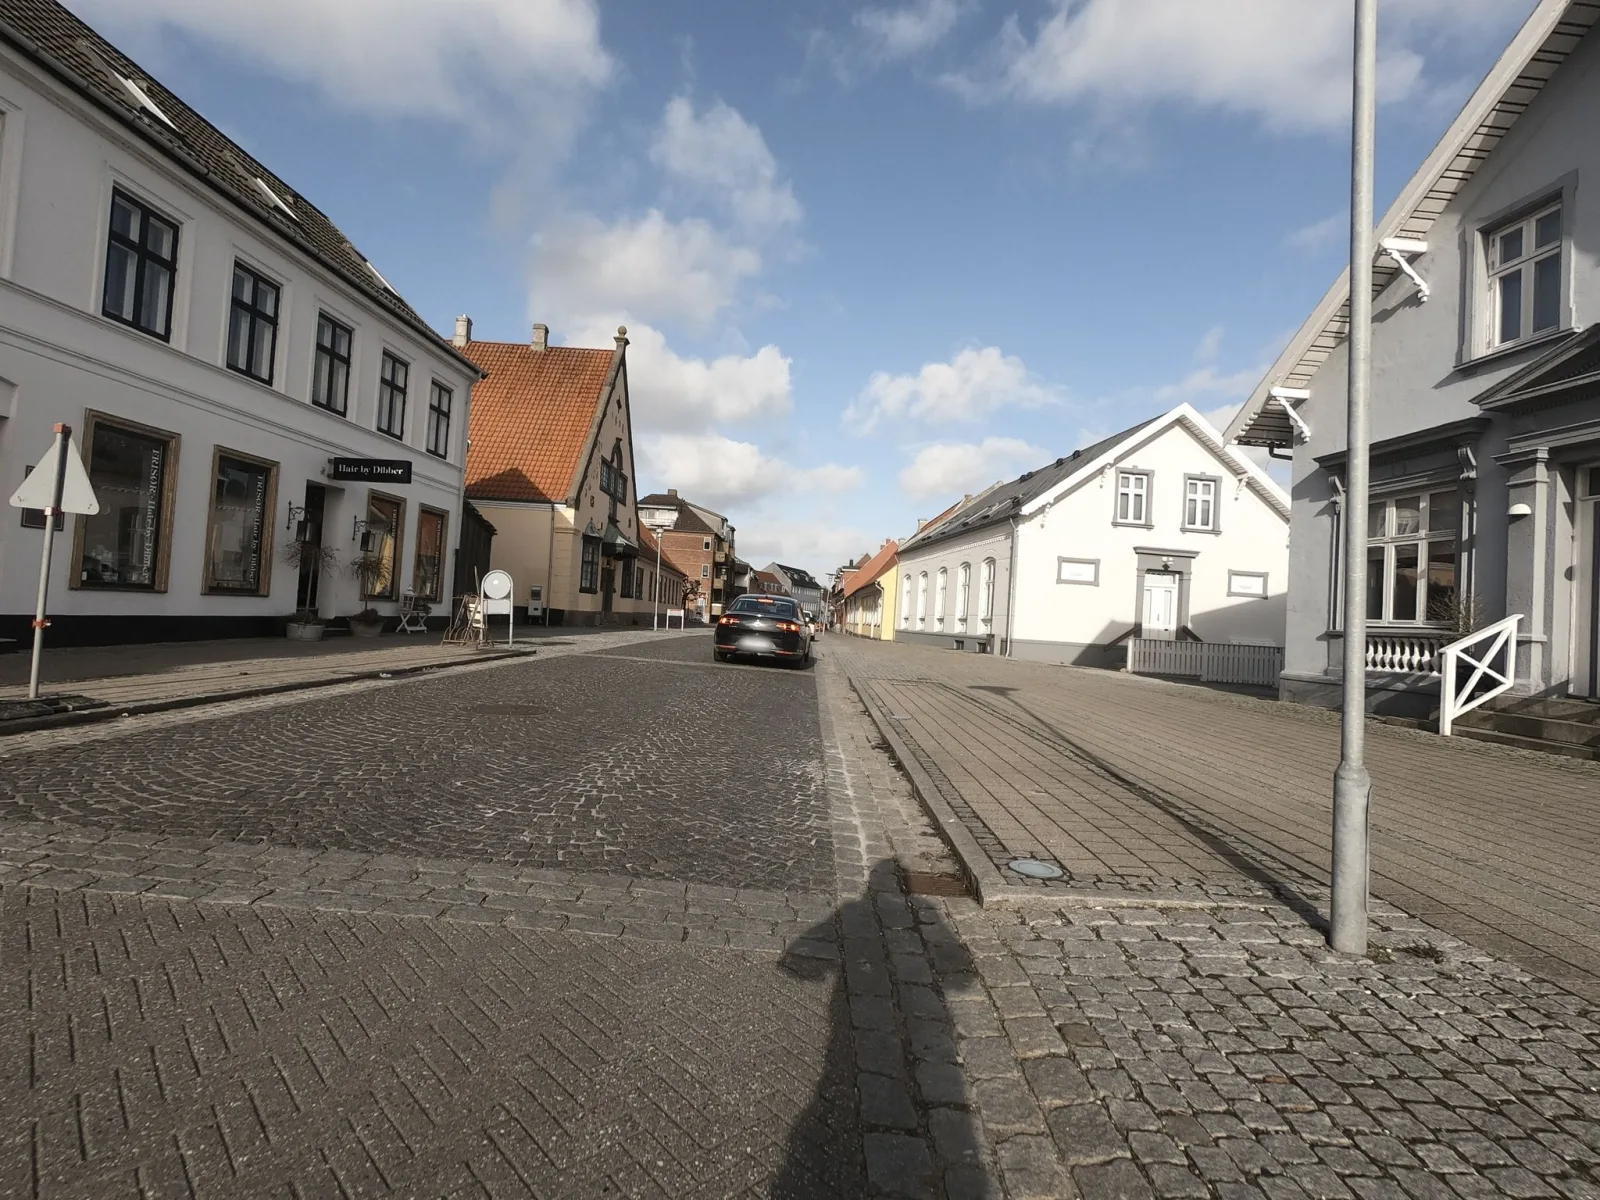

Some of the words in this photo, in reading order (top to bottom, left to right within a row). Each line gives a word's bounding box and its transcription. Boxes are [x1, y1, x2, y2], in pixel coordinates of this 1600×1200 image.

[338, 464, 359, 473] Hair
[360, 465, 371, 476] by
[373, 465, 404, 475] Dibber
